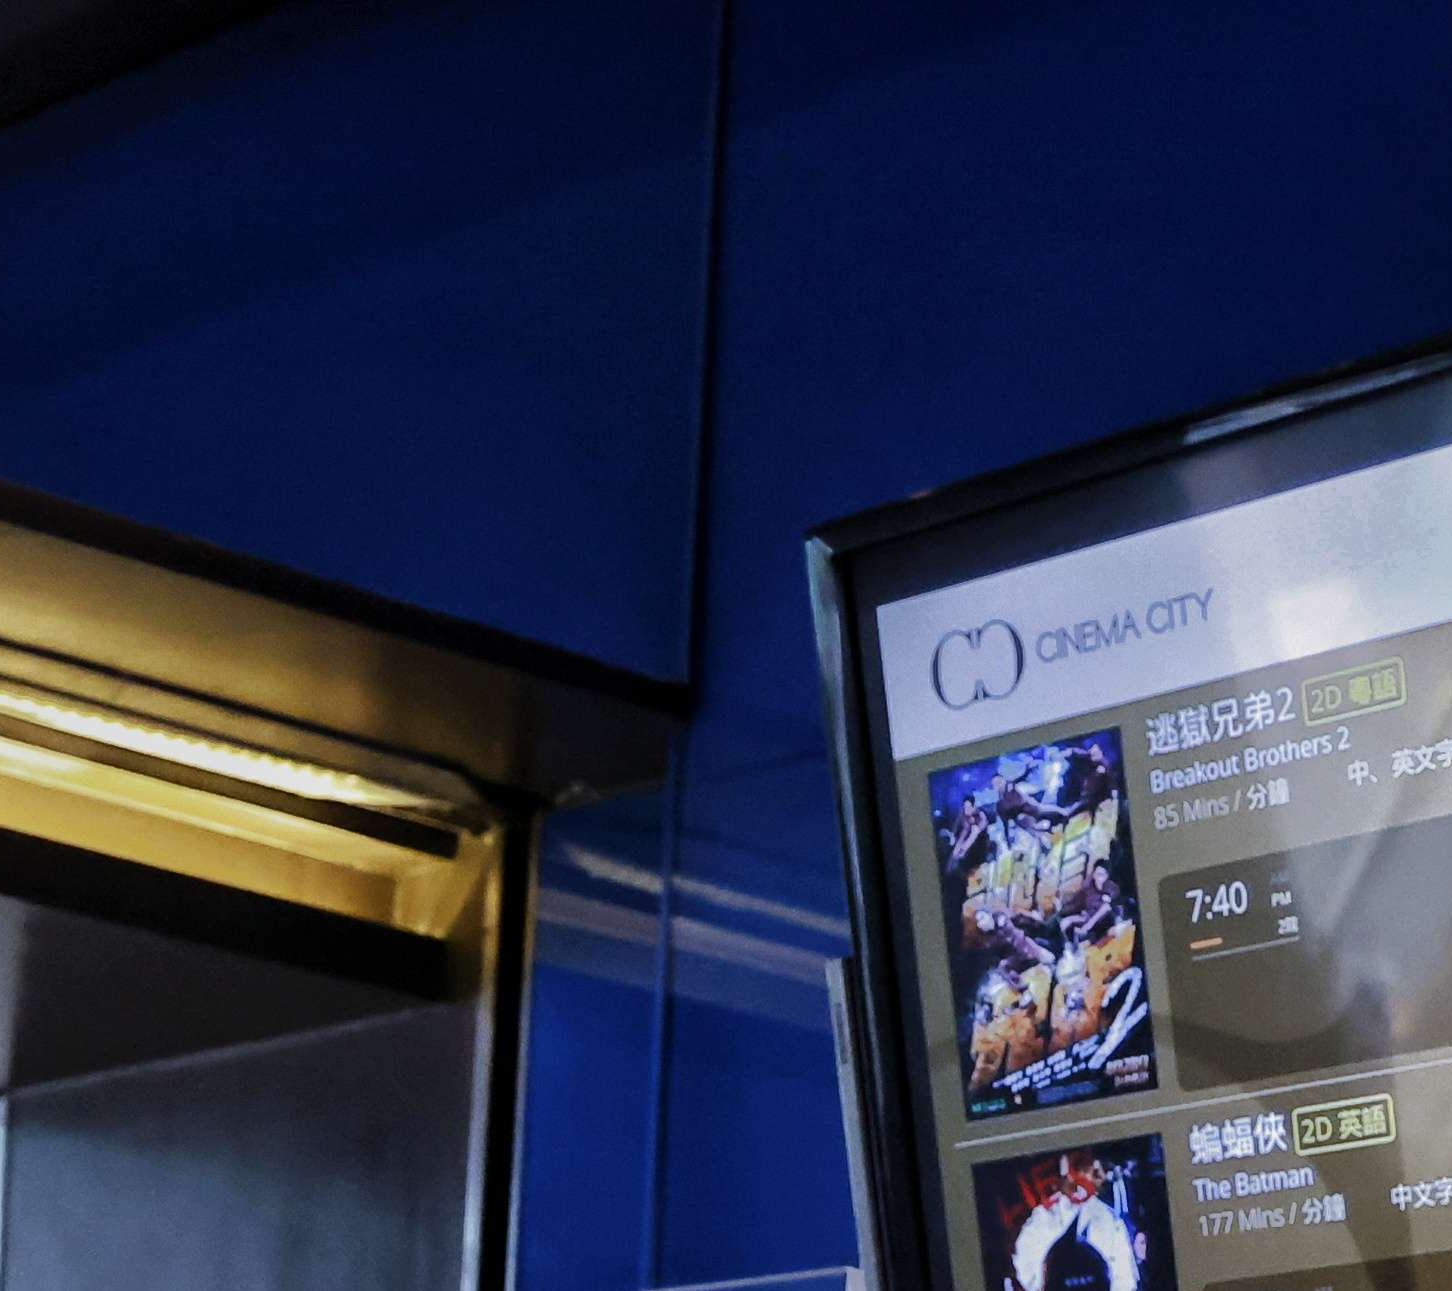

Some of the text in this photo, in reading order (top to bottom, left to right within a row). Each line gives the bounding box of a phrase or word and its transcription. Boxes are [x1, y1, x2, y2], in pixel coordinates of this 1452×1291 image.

[1035, 588, 1215, 665] CINEMA CITY
[1146, 686, 1296, 757] 逃獄兄弟2
[1309, 685, 1343, 715] 2D
[1149, 725, 1352, 796] Breakout Brothers 2
[1152, 803, 1180, 832] 85
[1183, 794, 1230, 825] Mins
[1184, 880, 1248, 924] 7:40
[1188, 1111, 1288, 1165] 蝙蝠俠
[1299, 1103, 1387, 1145] 2D 英語
[1192, 1165, 1315, 1203] The Batman
[1198, 1209, 1235, 1238] 177
[1237, 1204, 1286, 1233] Mins
